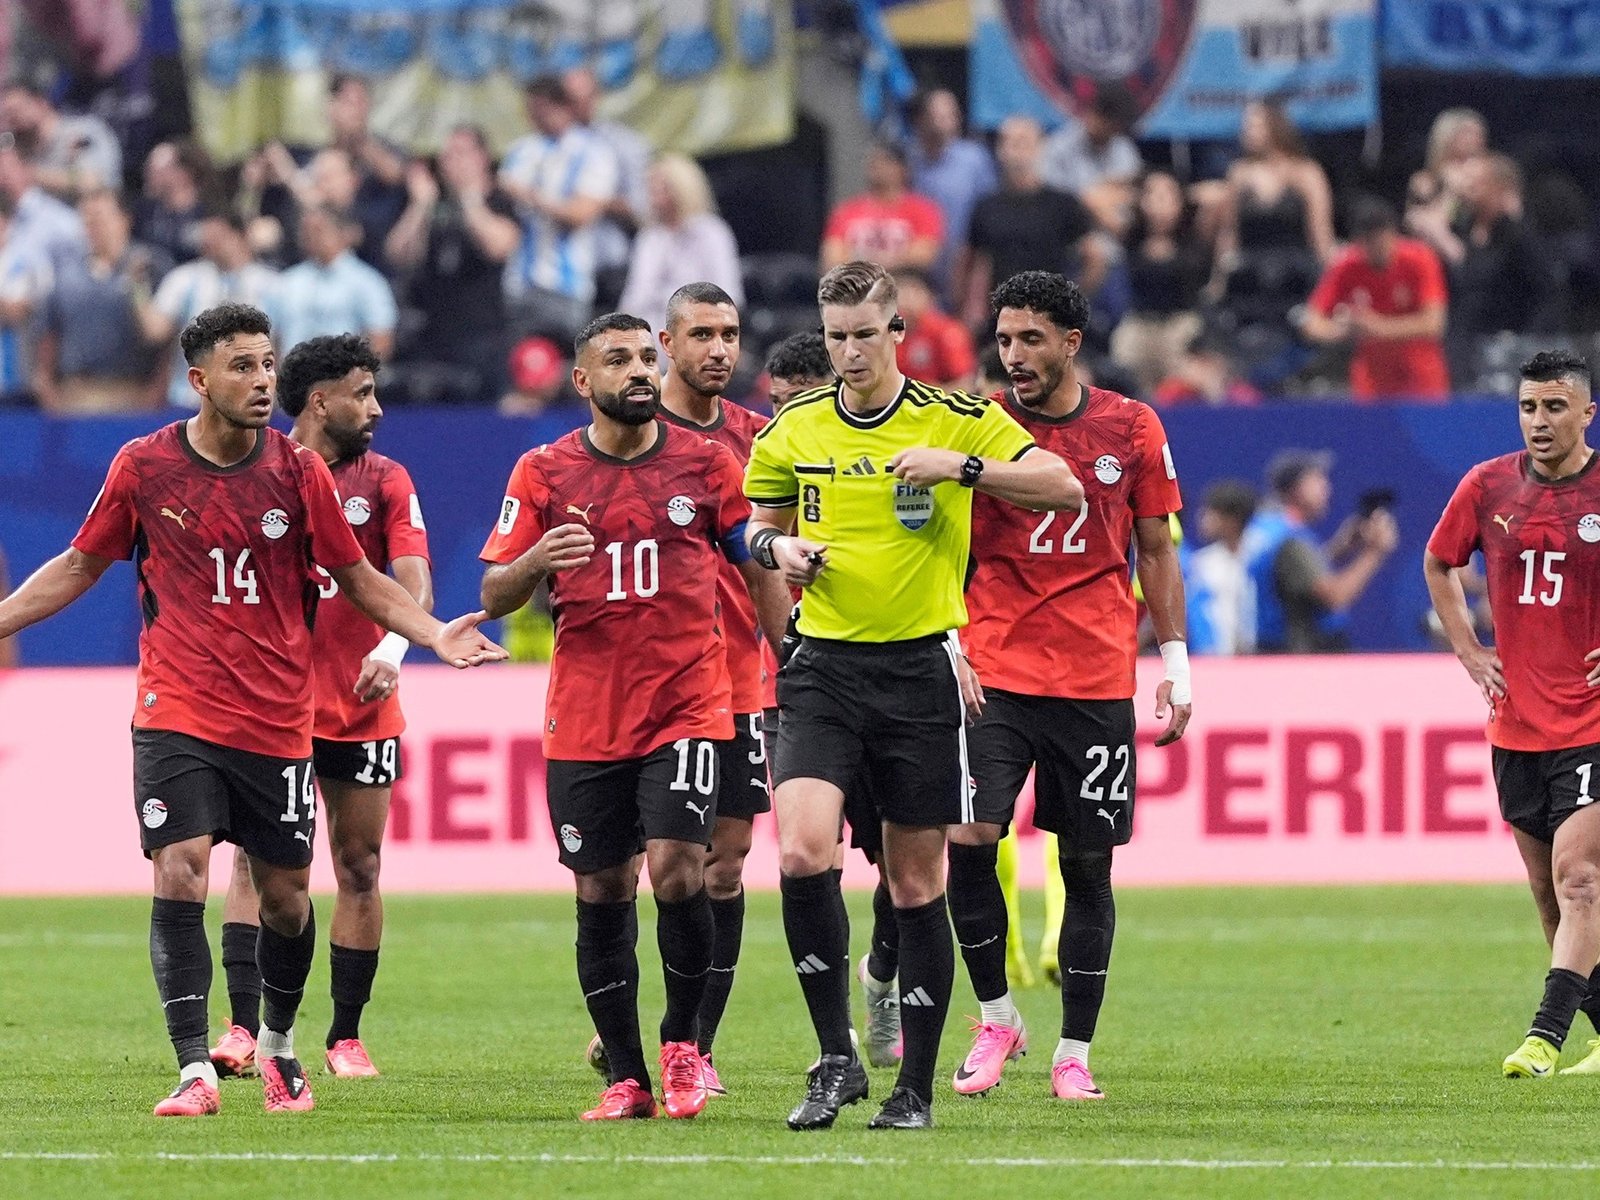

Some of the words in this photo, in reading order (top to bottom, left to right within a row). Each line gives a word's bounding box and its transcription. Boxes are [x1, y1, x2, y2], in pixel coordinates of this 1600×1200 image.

[897, 484, 930, 496] FIFA
[1029, 498, 1089, 554] 22
[208, 548, 260, 604] 14
[605, 539, 659, 601] 10
[1518, 549, 1567, 606] 15
[355, 739, 396, 784] 19
[670, 738, 714, 795] 10
[748, 712, 765, 765] 5
[281, 762, 316, 822] 14
[1080, 744, 1129, 801] 22
